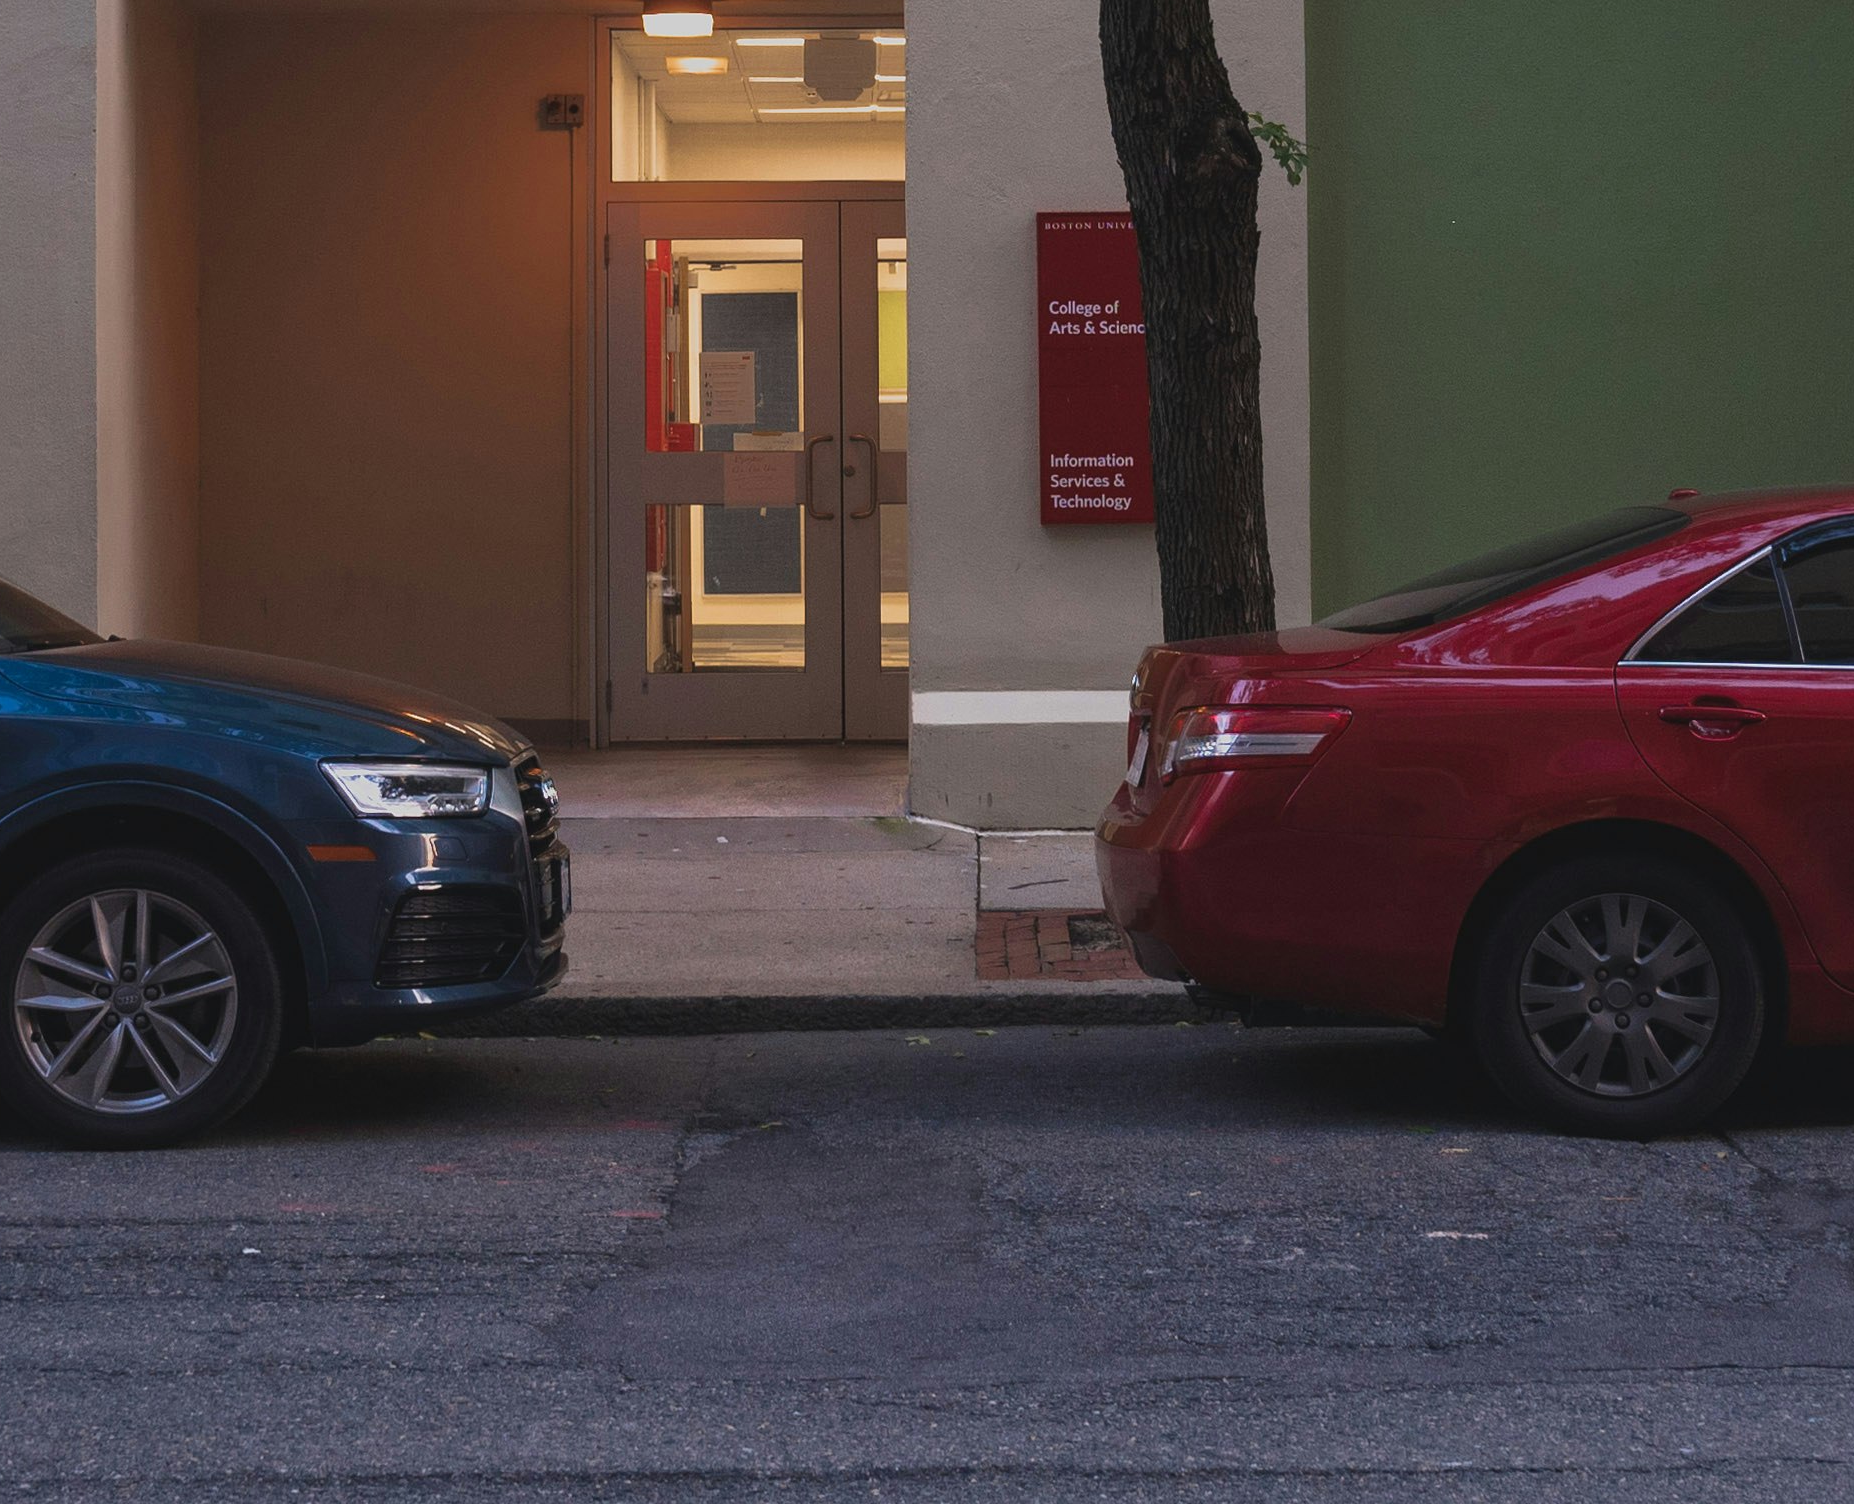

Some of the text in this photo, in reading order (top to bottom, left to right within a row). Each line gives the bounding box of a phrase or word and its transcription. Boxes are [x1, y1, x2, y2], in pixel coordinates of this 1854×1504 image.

[1044, 221, 1092, 230] BOSTON
[1048, 299, 1120, 318] College of
[1049, 321, 1081, 335] Arts
[1084, 320, 1096, 335] &
[1050, 453, 1134, 468] Information
[1050, 473, 1126, 488] Services &
[1050, 493, 1132, 511] Technology
